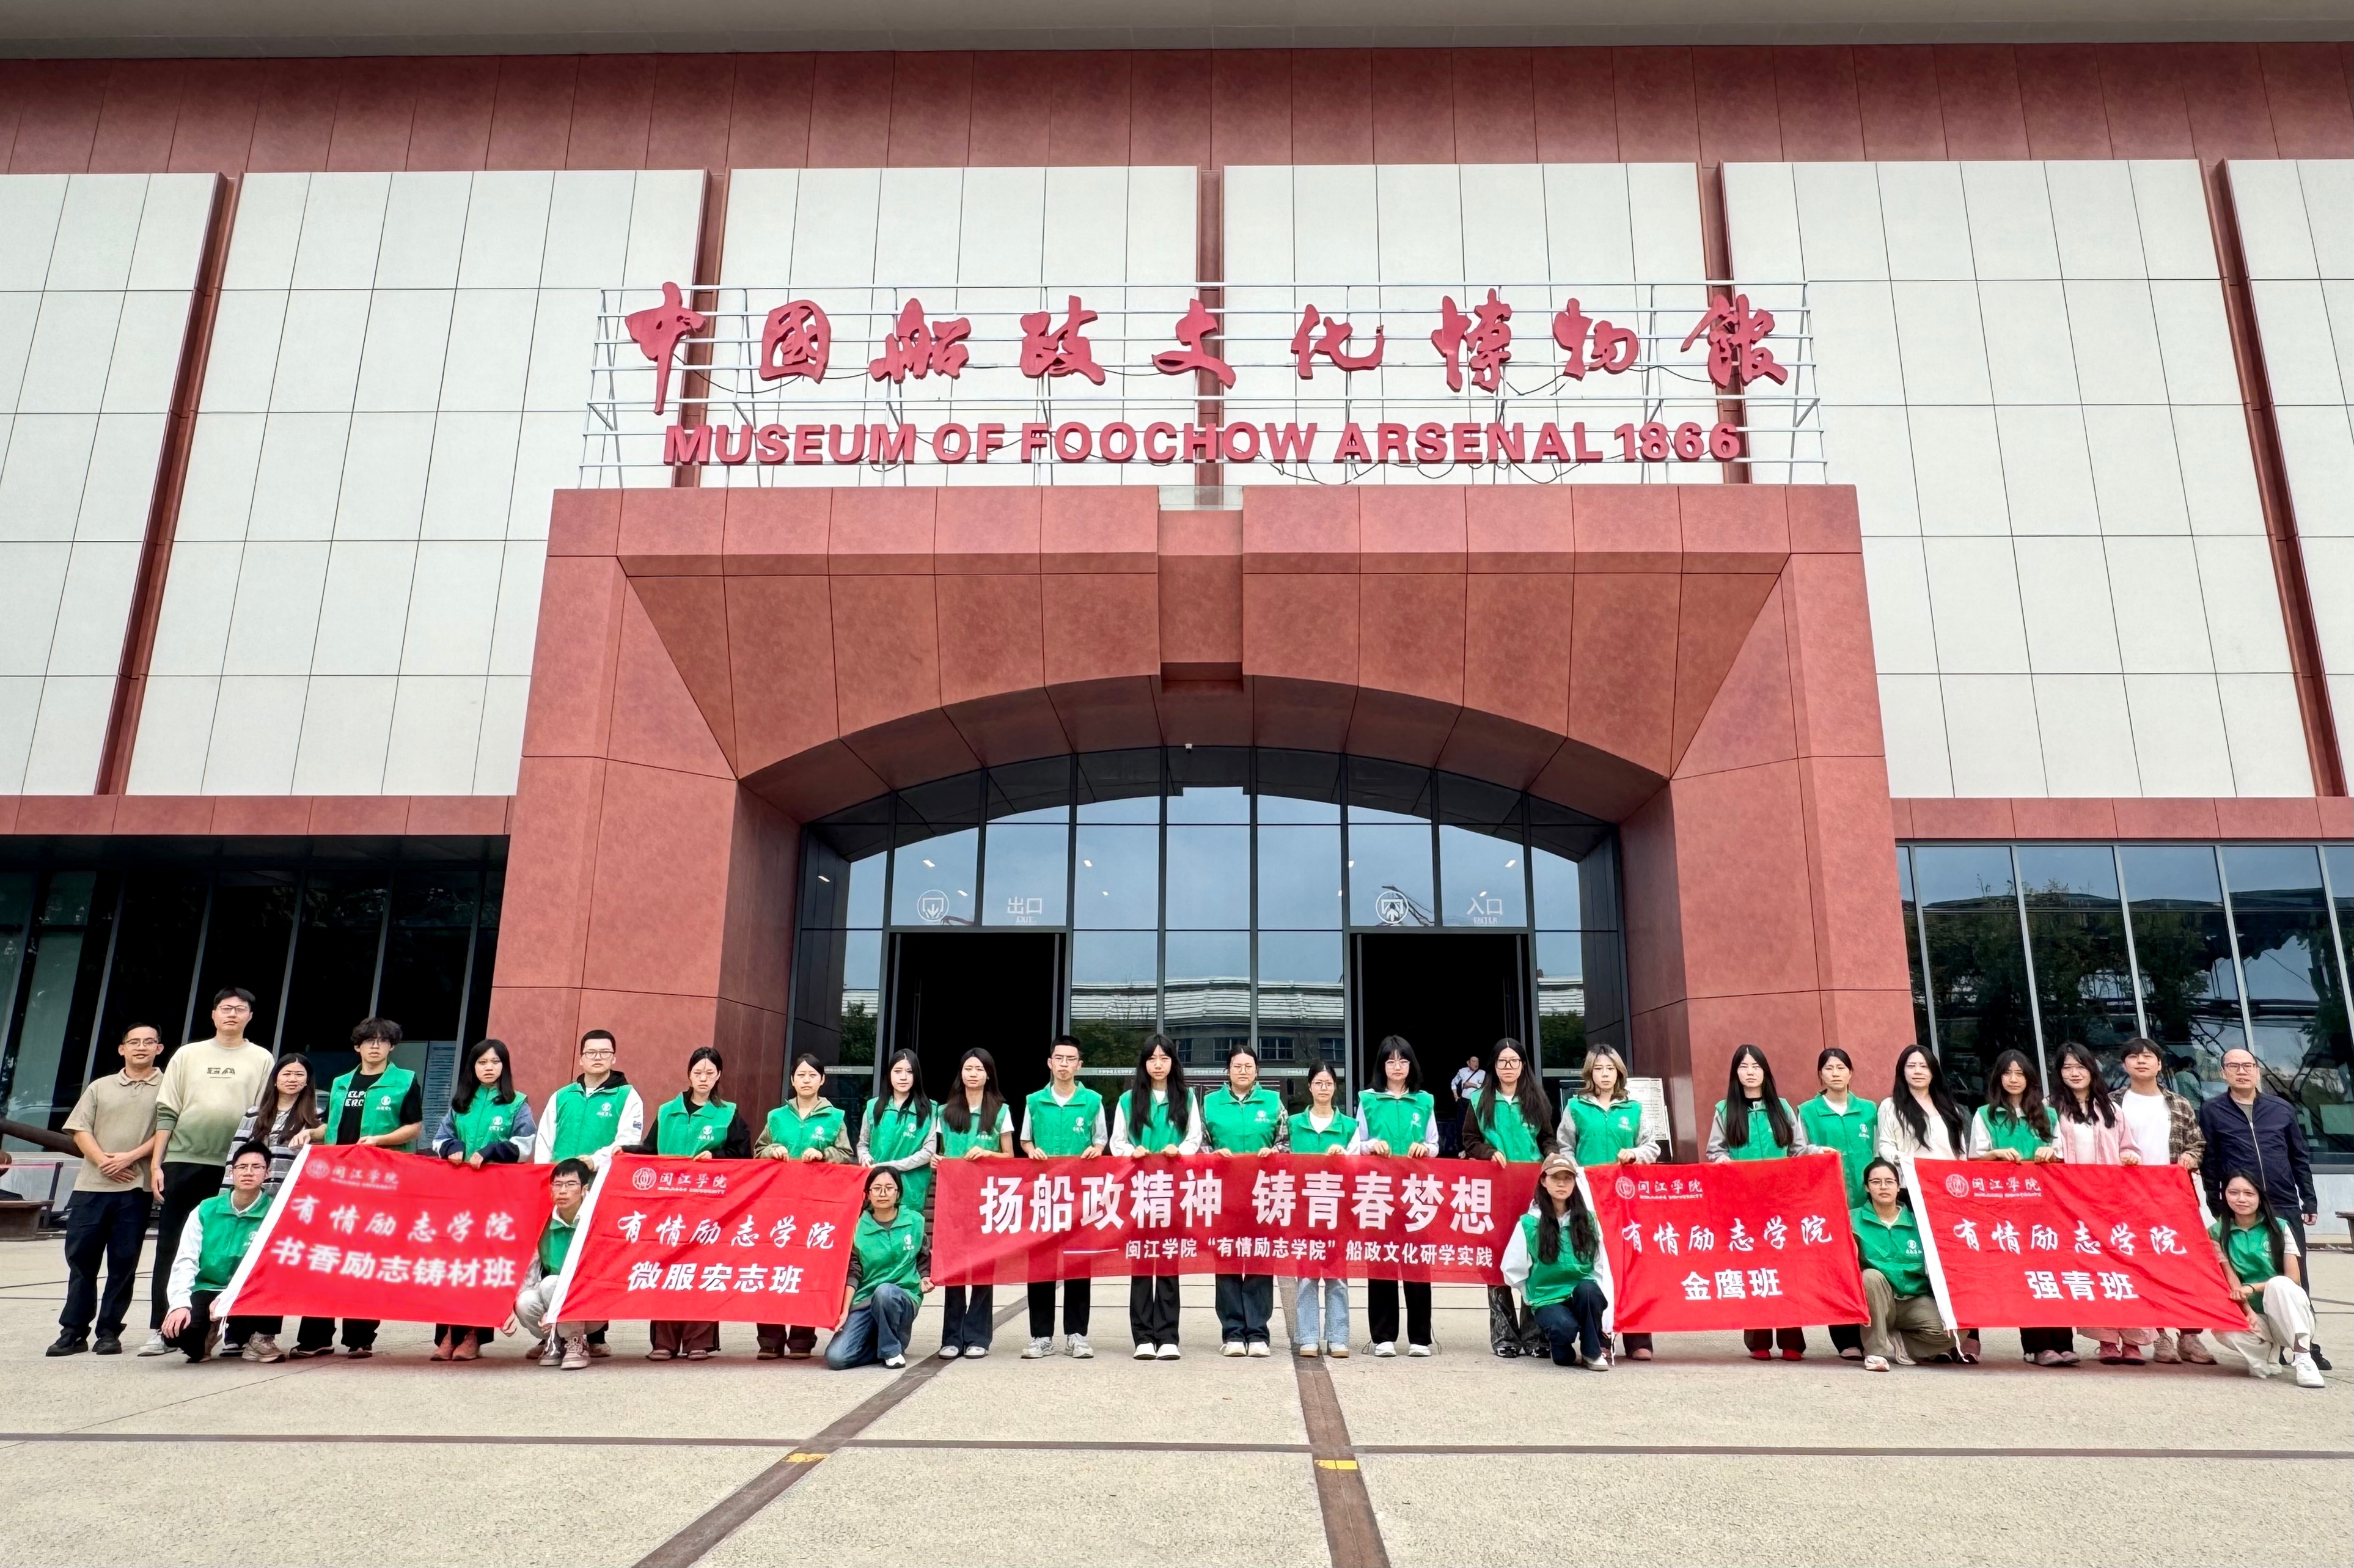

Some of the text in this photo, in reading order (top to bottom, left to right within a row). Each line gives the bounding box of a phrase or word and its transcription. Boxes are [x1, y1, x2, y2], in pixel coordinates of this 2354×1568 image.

[664, 421, 1740, 466] MUSEUM OF FOOCHOW ARSENAL 1866
[1007, 896, 1042, 915] 出口
[1467, 897, 1503, 915] 入口
[290, 1194, 517, 1243] 有情励志学院
[978, 1168, 1495, 1234] 扬船政精神 铸青春梦想
[617, 1210, 836, 1250] 有情励志学院
[1621, 1214, 1833, 1256] 有情励志学院
[1953, 1218, 2188, 1256] 有情励志学院
[271, 1236, 518, 1288] 书香励志铸材班
[626, 1260, 805, 1294] 微服宏志班
[1681, 1267, 1784, 1301] 金鹰班
[2023, 1270, 2140, 1302] 强青班
